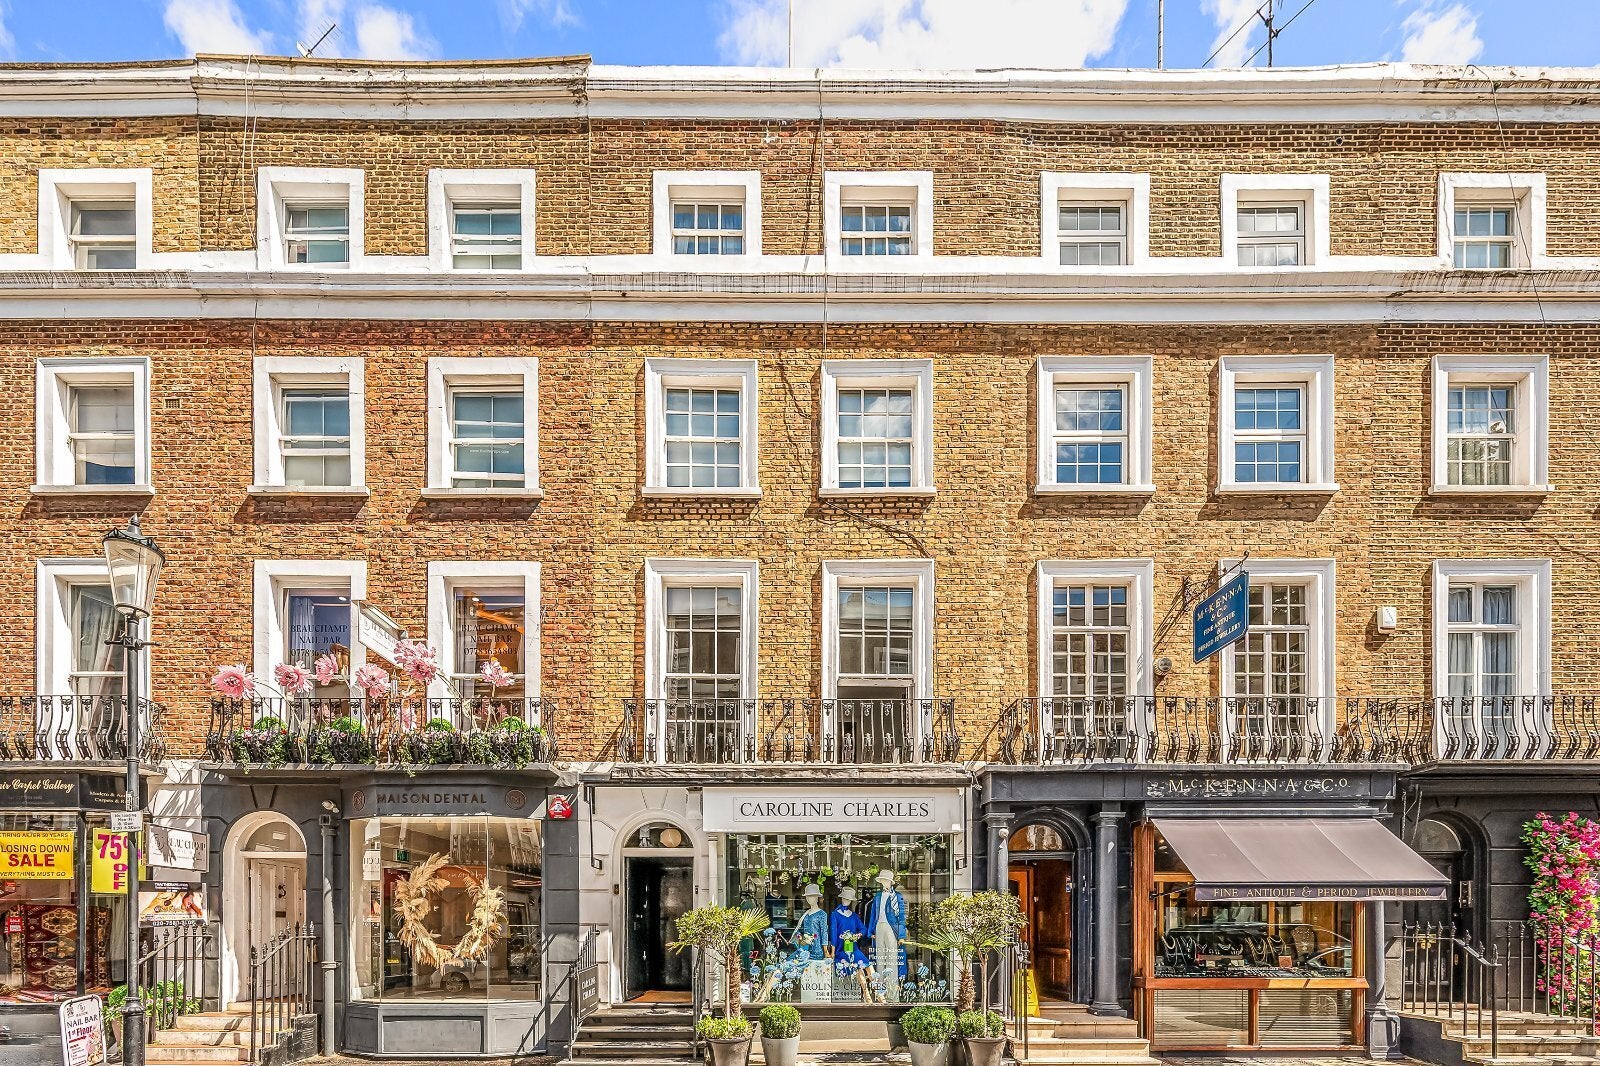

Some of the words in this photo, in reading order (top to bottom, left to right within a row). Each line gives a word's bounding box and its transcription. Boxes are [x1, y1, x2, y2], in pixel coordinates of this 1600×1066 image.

[290, 624, 348, 633] BEAUCHAMP
[300, 636, 320, 644] NAIL
[323, 636, 341, 644] BAR
[495, 635, 513, 643] BAR
[12, 779, 42, 793] Carpet
[42, 779, 75, 794] Gallery
[1303, 779, 1315, 792] &
[376, 793, 430, 804] MAISON
[434, 793, 488, 804] DENTAL
[740, 802, 834, 817] CAROLINE
[843, 802, 930, 818] CHARLES
[40, 844, 70, 853] DOWN
[8, 853, 55, 867] SALE
[113, 863, 128, 890] OFF
[1213, 888, 1239, 897] FINE
[1246, 888, 1296, 898] ANTIQUE
[1301, 886, 1313, 898] &
[1317, 888, 1358, 897] PERIOD
[1366, 887, 1430, 897] JEWELLERY
[67, 1018, 84, 1029] NAIL
[84, 1013, 99, 1024] BAR
[77, 1025, 93, 1037] Floor
